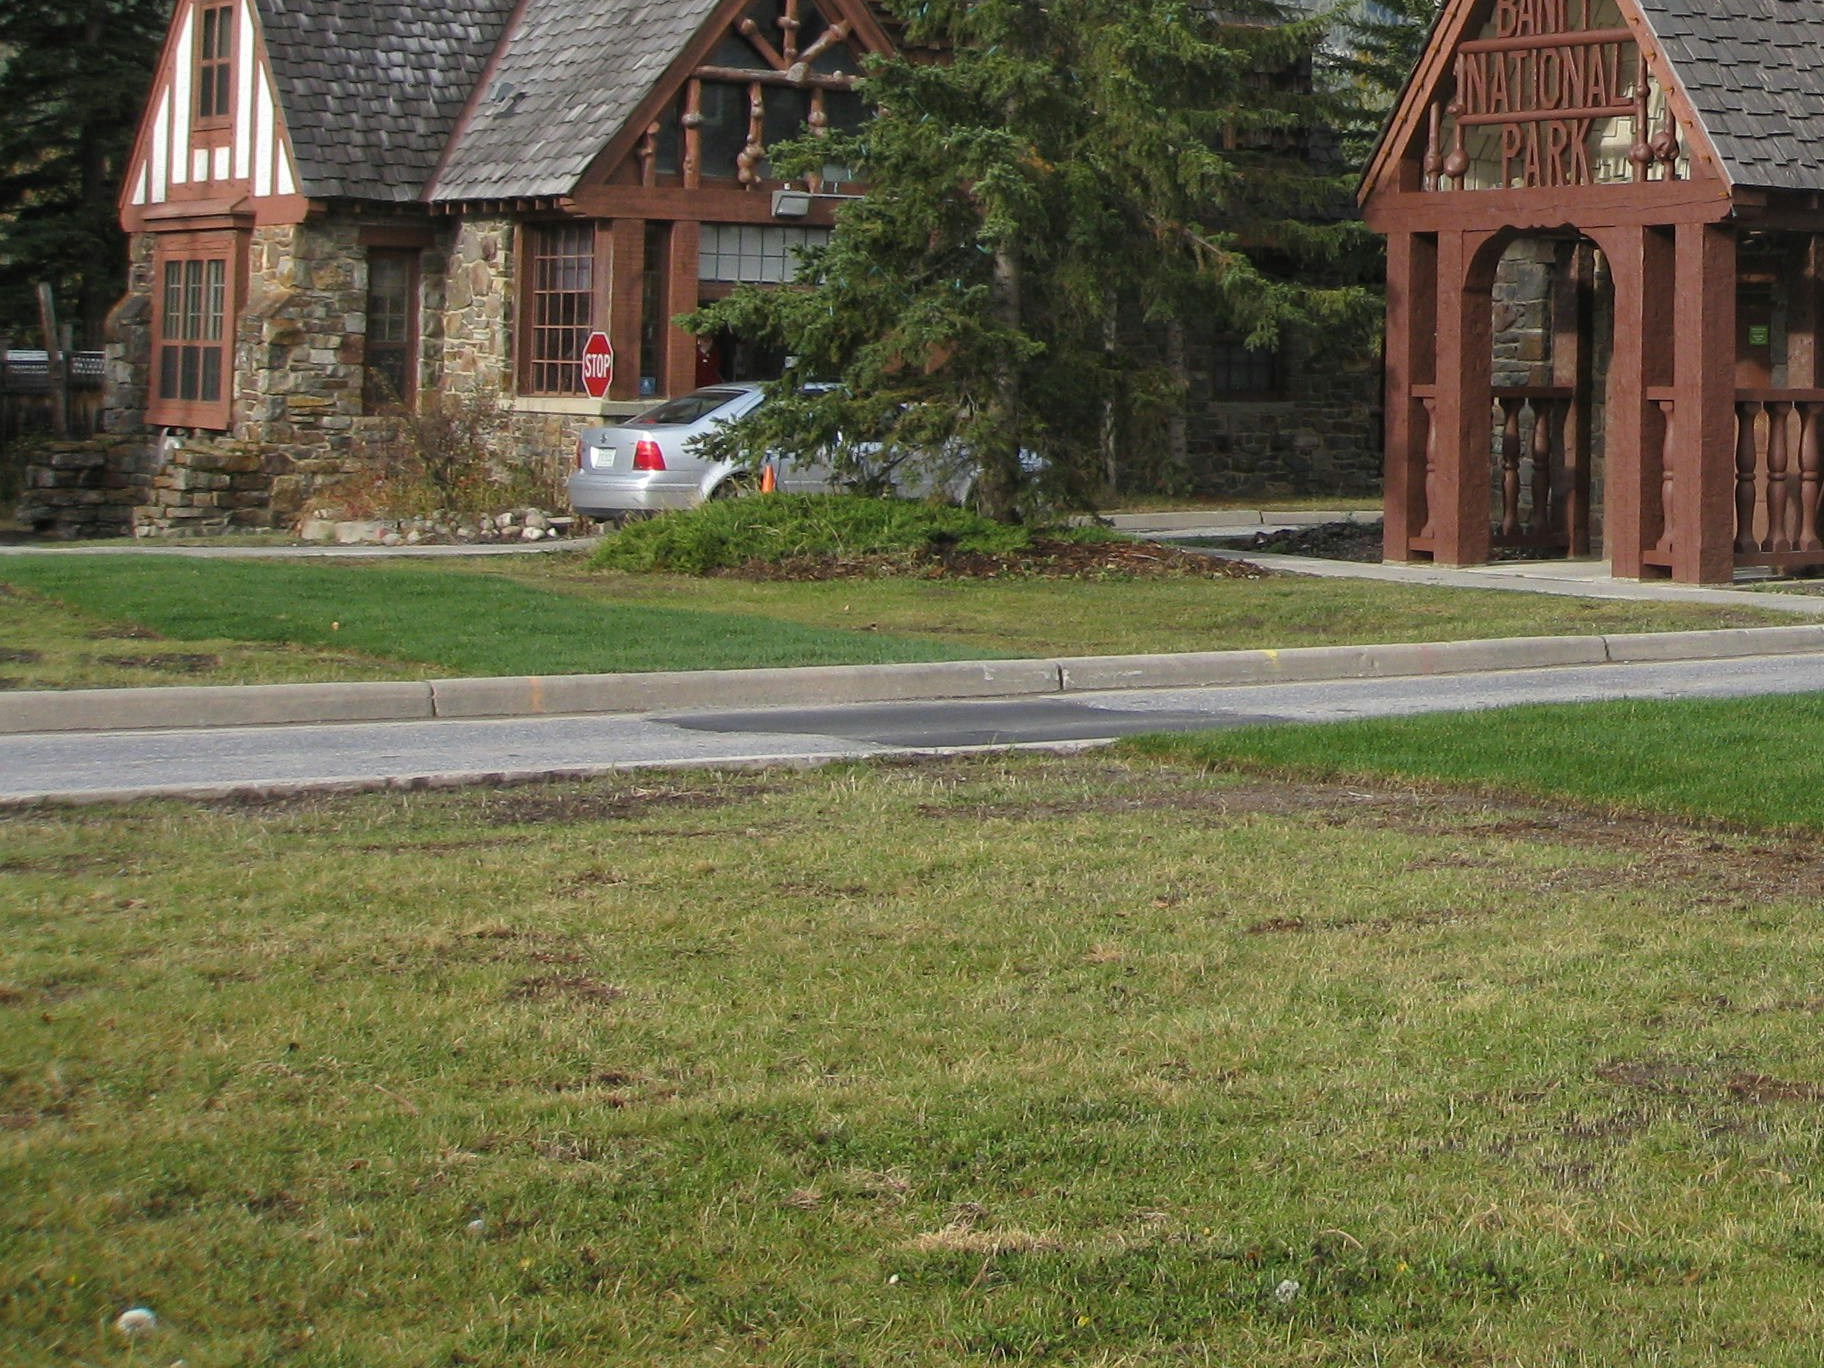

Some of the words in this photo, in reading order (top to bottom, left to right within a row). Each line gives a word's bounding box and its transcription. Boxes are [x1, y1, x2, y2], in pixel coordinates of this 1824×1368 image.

[1463, 44, 1633, 115] NATIONAL
[1503, 119, 1594, 188] PARK
[585, 354, 611, 378] STOP
